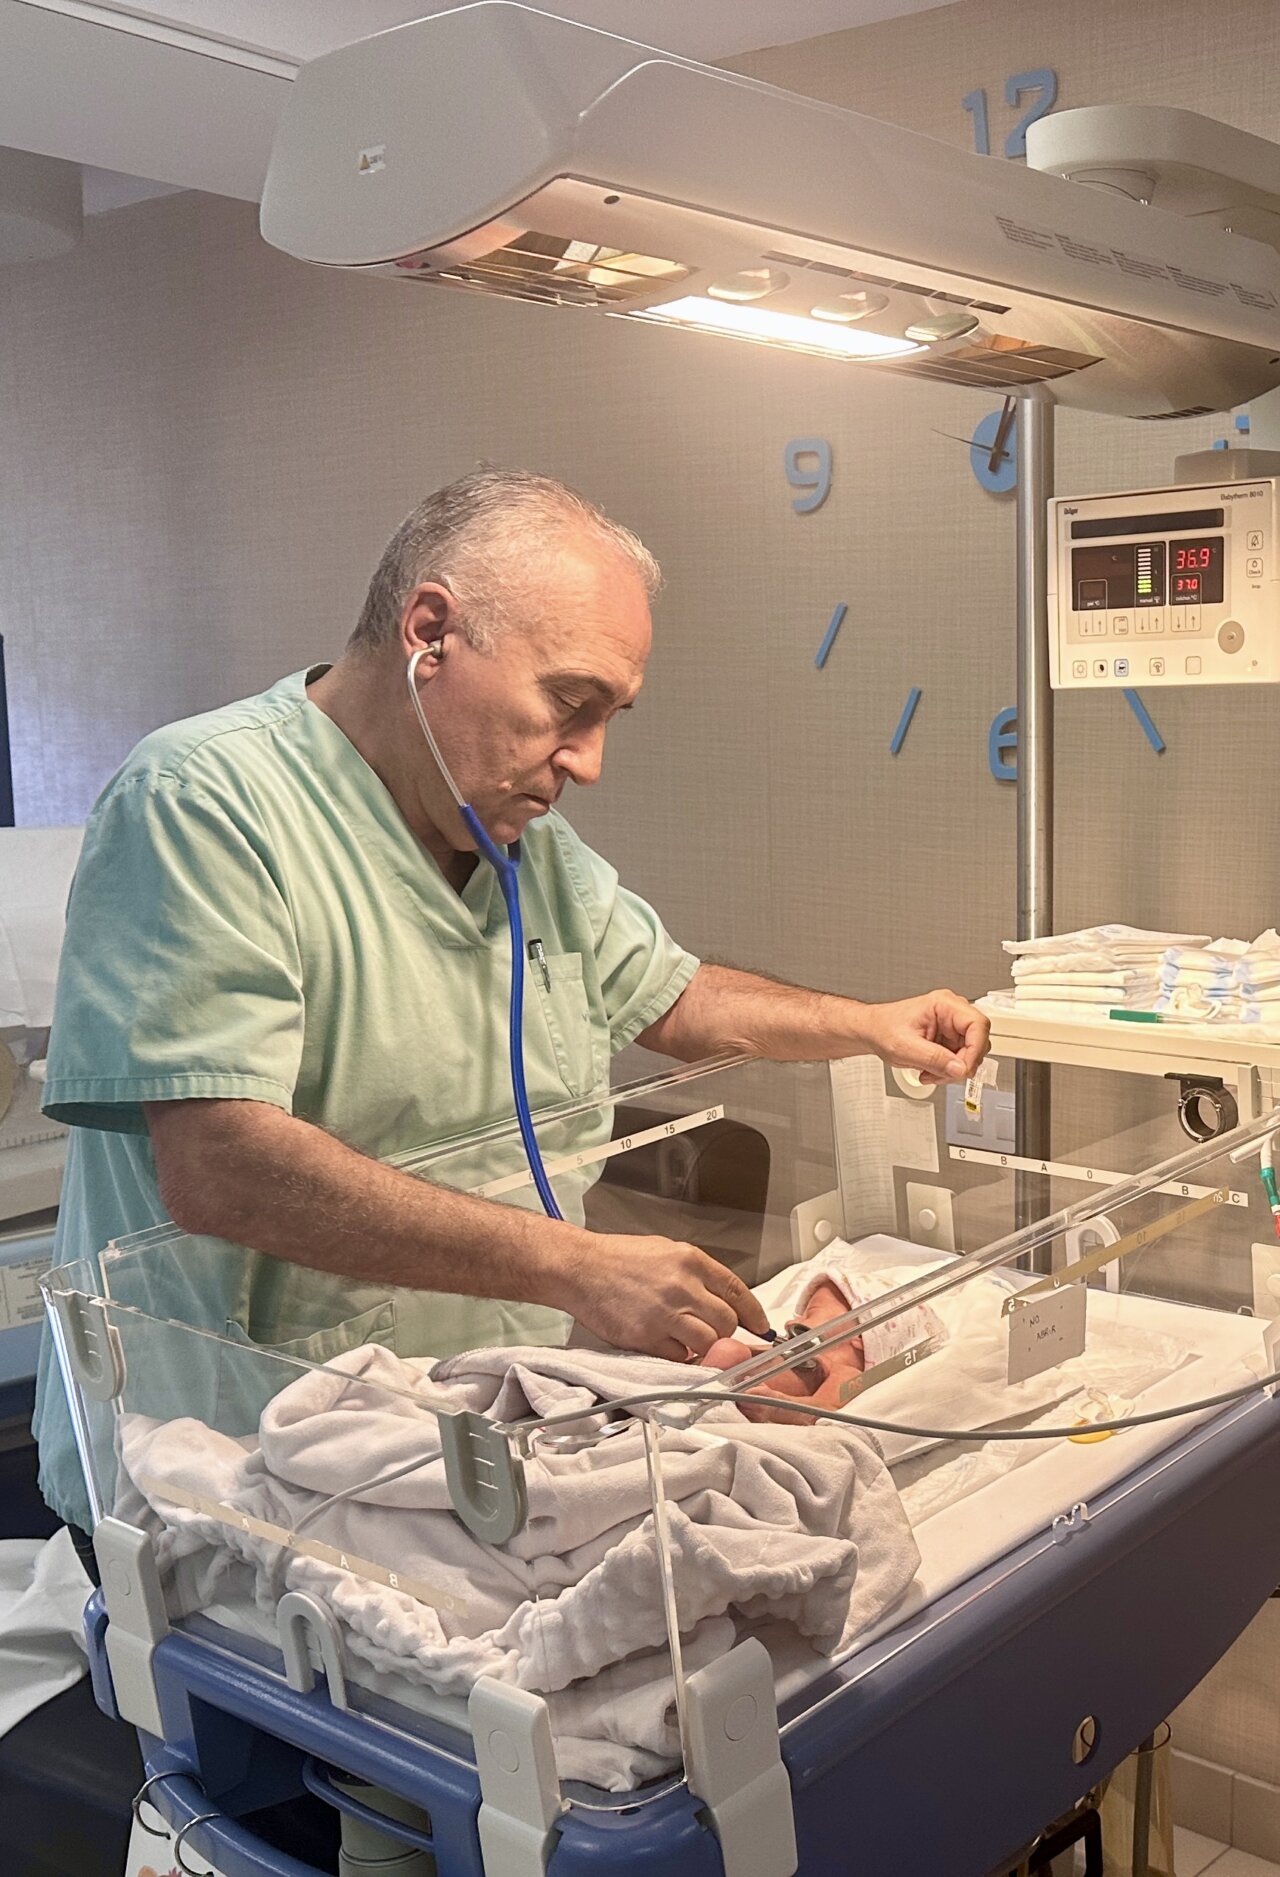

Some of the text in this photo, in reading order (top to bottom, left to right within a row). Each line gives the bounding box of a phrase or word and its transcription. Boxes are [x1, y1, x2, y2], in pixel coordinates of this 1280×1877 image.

[961, 68, 1057, 157] 12
[784, 436, 832, 513] 9
[1249, 489, 1264, 498] 8010
[1176, 547, 1210, 569] 36.9
[577, 1155, 583, 1165] 5
[620, 1138, 632, 1150] 10
[664, 1124, 676, 1135] 15
[706, 1109, 717, 1120] 20
[959, 1149, 966, 1159] C
[1001, 1156, 1008, 1166] B
[1041, 1162, 1048, 1173] A
[1182, 1185, 1189, 1196] B
[1232, 1193, 1240, 1204] C
[1029, 1314, 1040, 1327] NO
